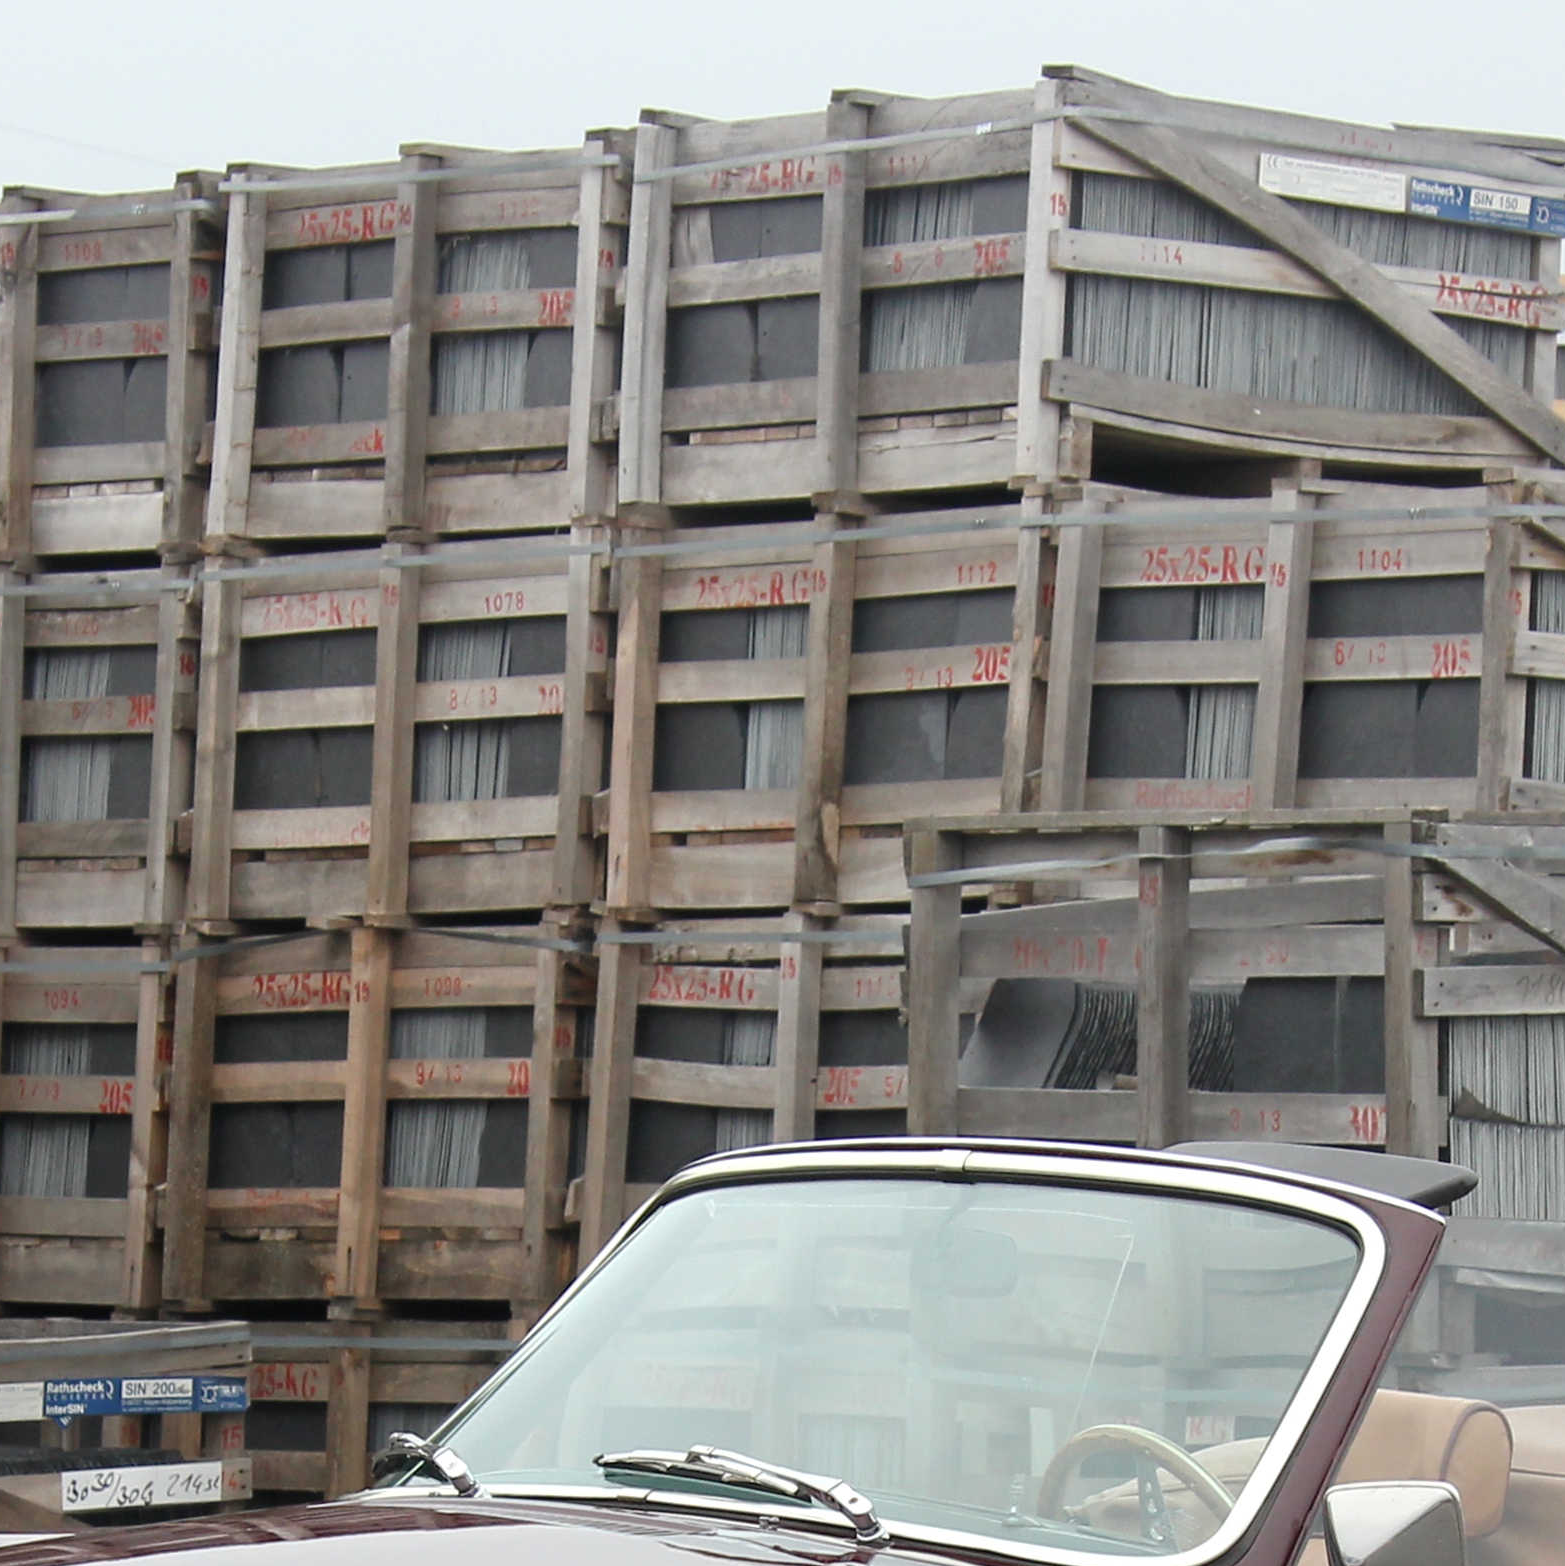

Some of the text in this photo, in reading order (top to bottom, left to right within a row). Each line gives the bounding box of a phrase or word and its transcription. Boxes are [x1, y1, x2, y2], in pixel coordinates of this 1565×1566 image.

[1050, 193, 1068, 217] 15
[1473, 192, 1519, 211] SIN 150
[1139, 544, 1265, 584] 25x25-R G
[484, 591, 525, 614] 1078
[972, 646, 1011, 682] 205
[98, 1081, 133, 1114] 205
[45, 1381, 105, 1396] Rathscheck
[124, 1381, 177, 1398] SIN 200
[45, 1402, 84, 1416] InterSIN
